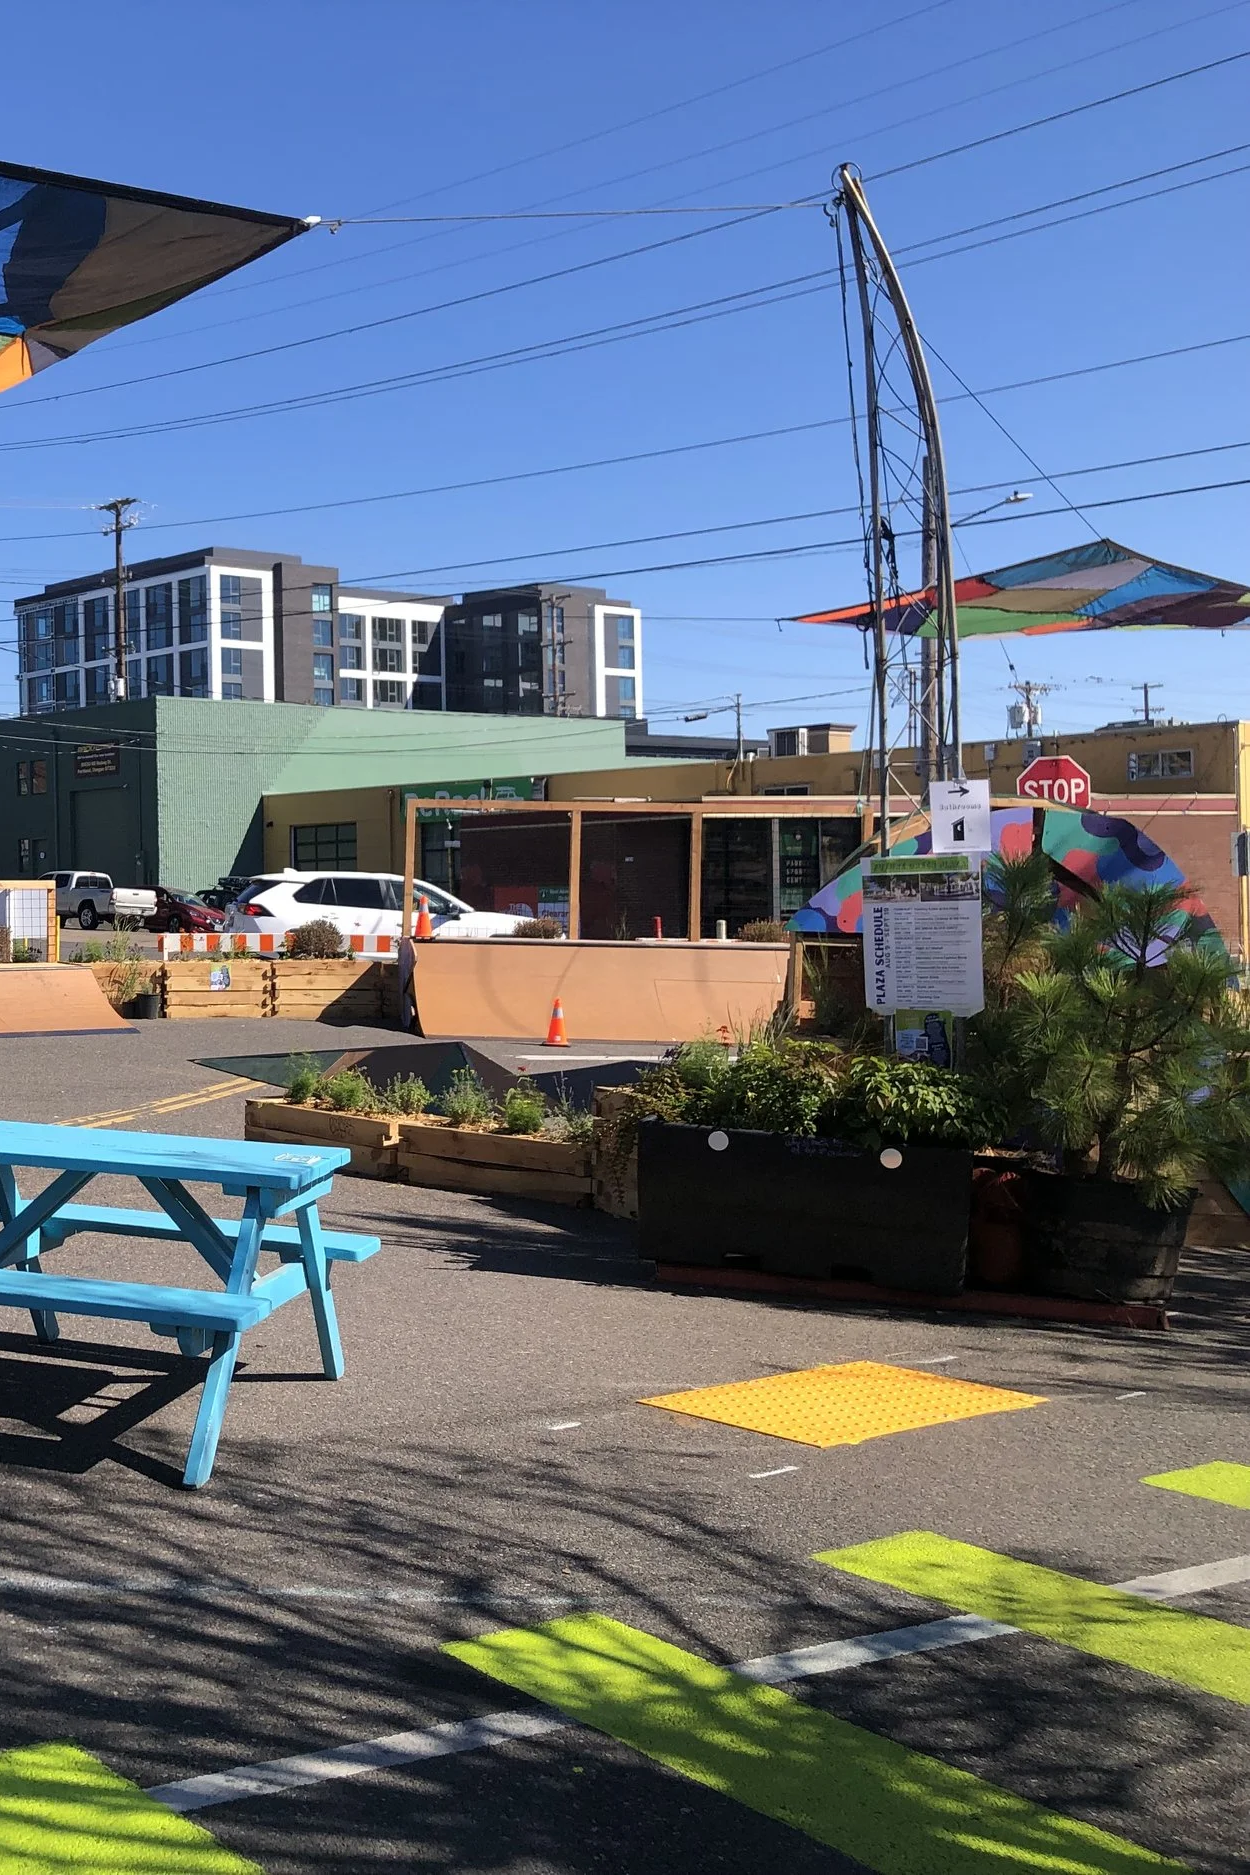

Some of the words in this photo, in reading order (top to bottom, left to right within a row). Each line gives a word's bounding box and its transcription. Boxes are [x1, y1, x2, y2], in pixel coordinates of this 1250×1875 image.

[1024, 778, 1085, 804] STOP
[873, 906, 885, 966] SCHEDULE
[875, 970, 886, 1005] PLAZA
